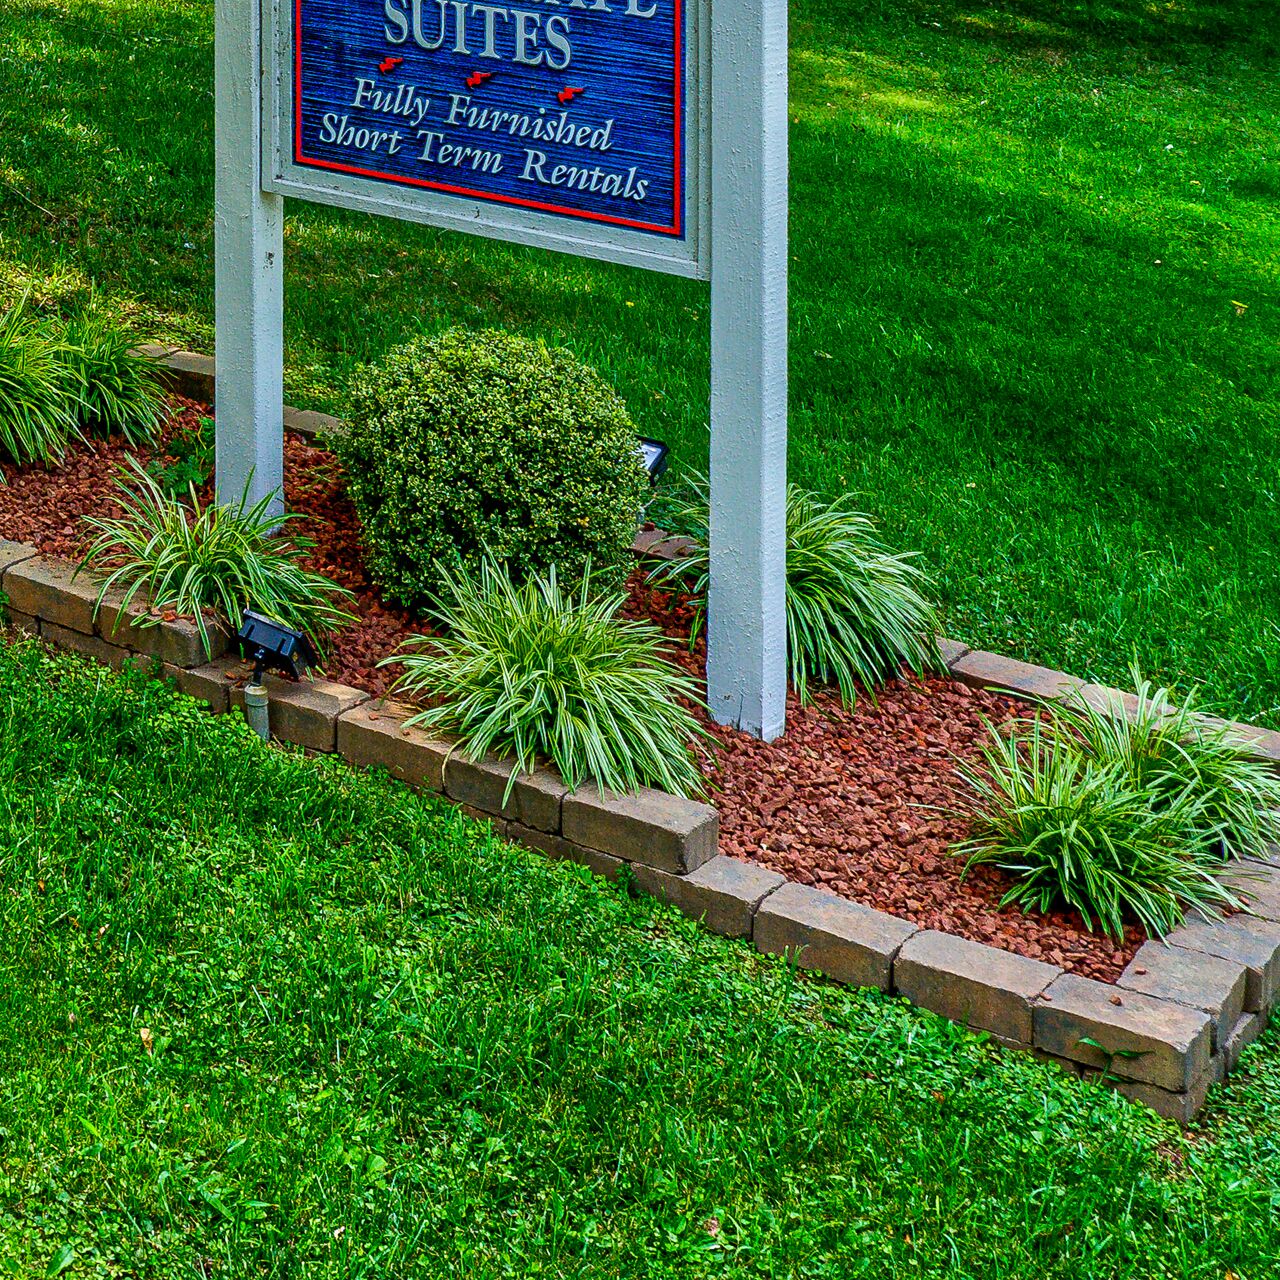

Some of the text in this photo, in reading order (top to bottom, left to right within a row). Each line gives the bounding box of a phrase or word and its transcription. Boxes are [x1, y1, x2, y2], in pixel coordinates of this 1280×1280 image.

[350, 76, 615, 151] Fully Furnished
[318, 112, 650, 201] Short Term Rentals
